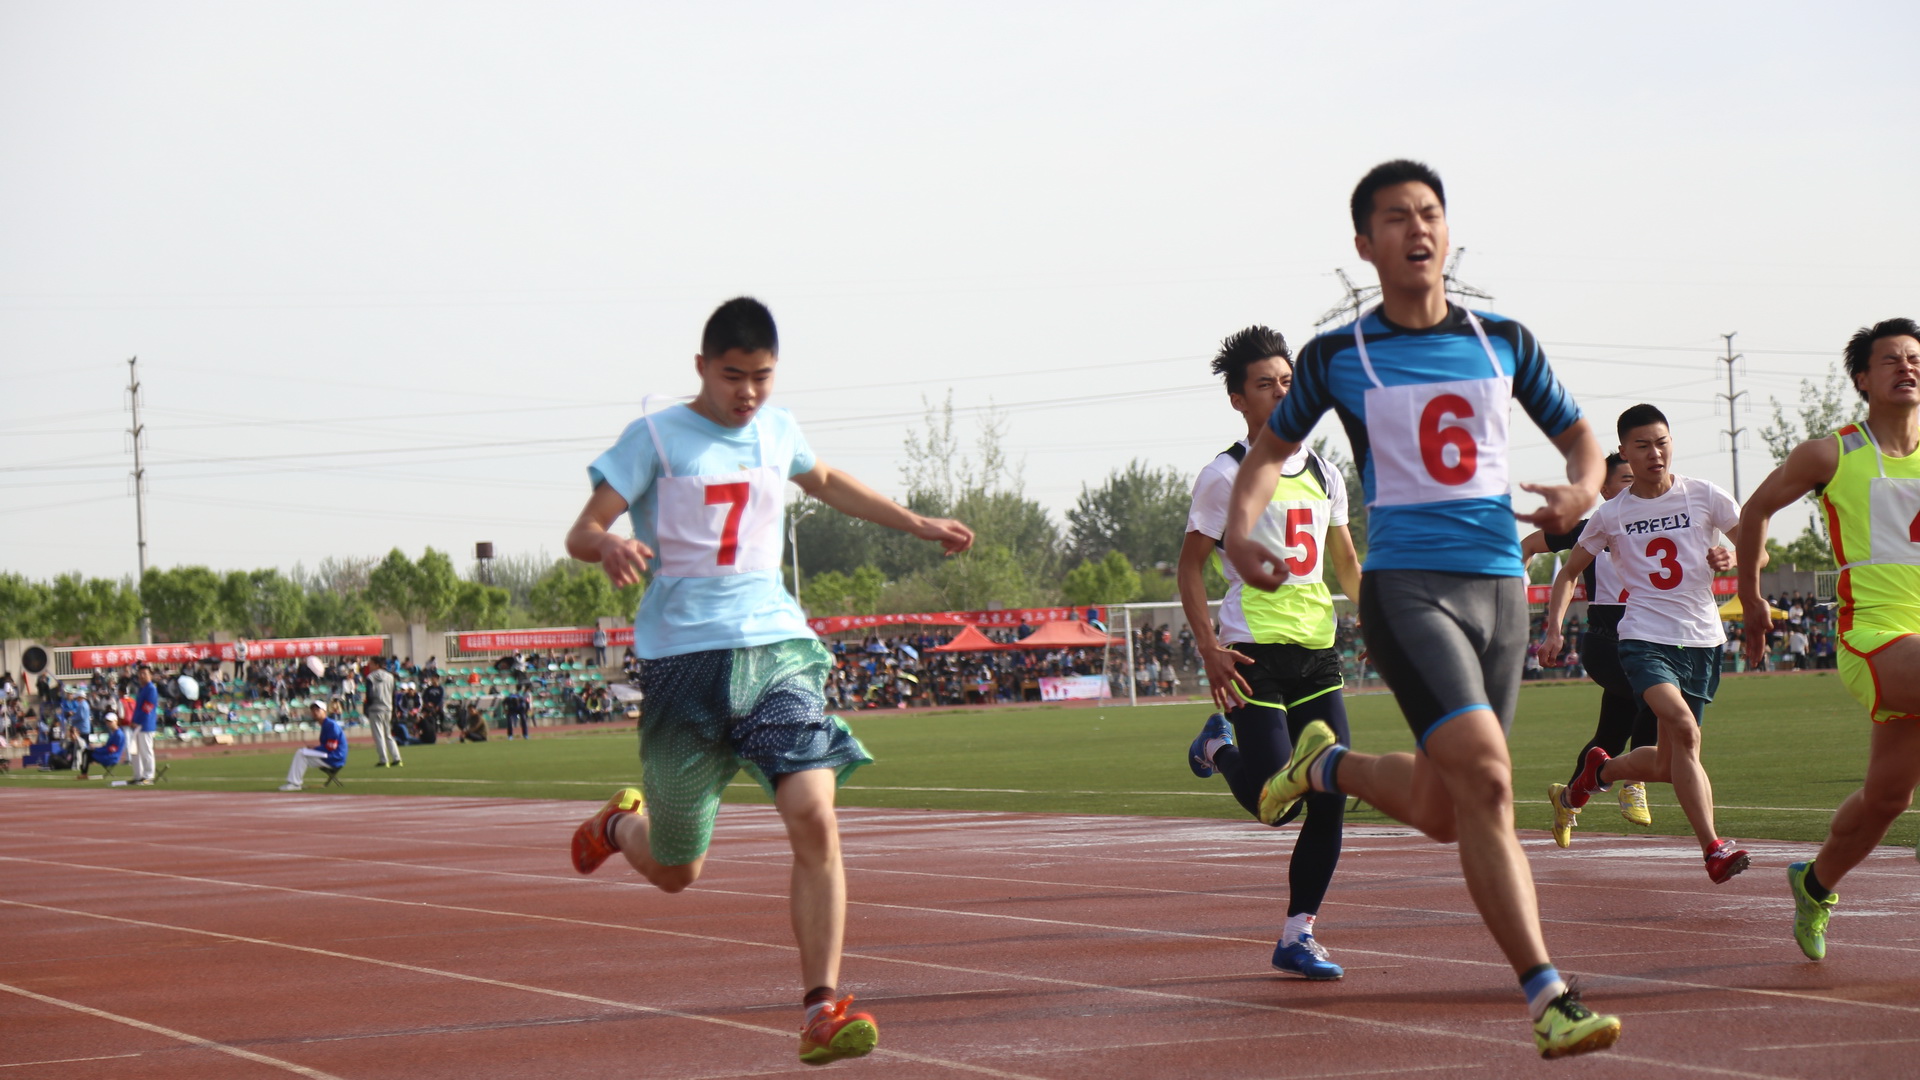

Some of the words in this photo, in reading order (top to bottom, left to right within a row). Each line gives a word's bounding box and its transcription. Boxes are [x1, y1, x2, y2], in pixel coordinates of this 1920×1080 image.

[1419, 393, 1478, 486] 6
[704, 482, 750, 566] 7
[1284, 508, 1318, 577] 5
[1625, 513, 1690, 535] FREELY
[1645, 537, 1683, 590] 3
[91, 649, 147, 666] 生命不息
